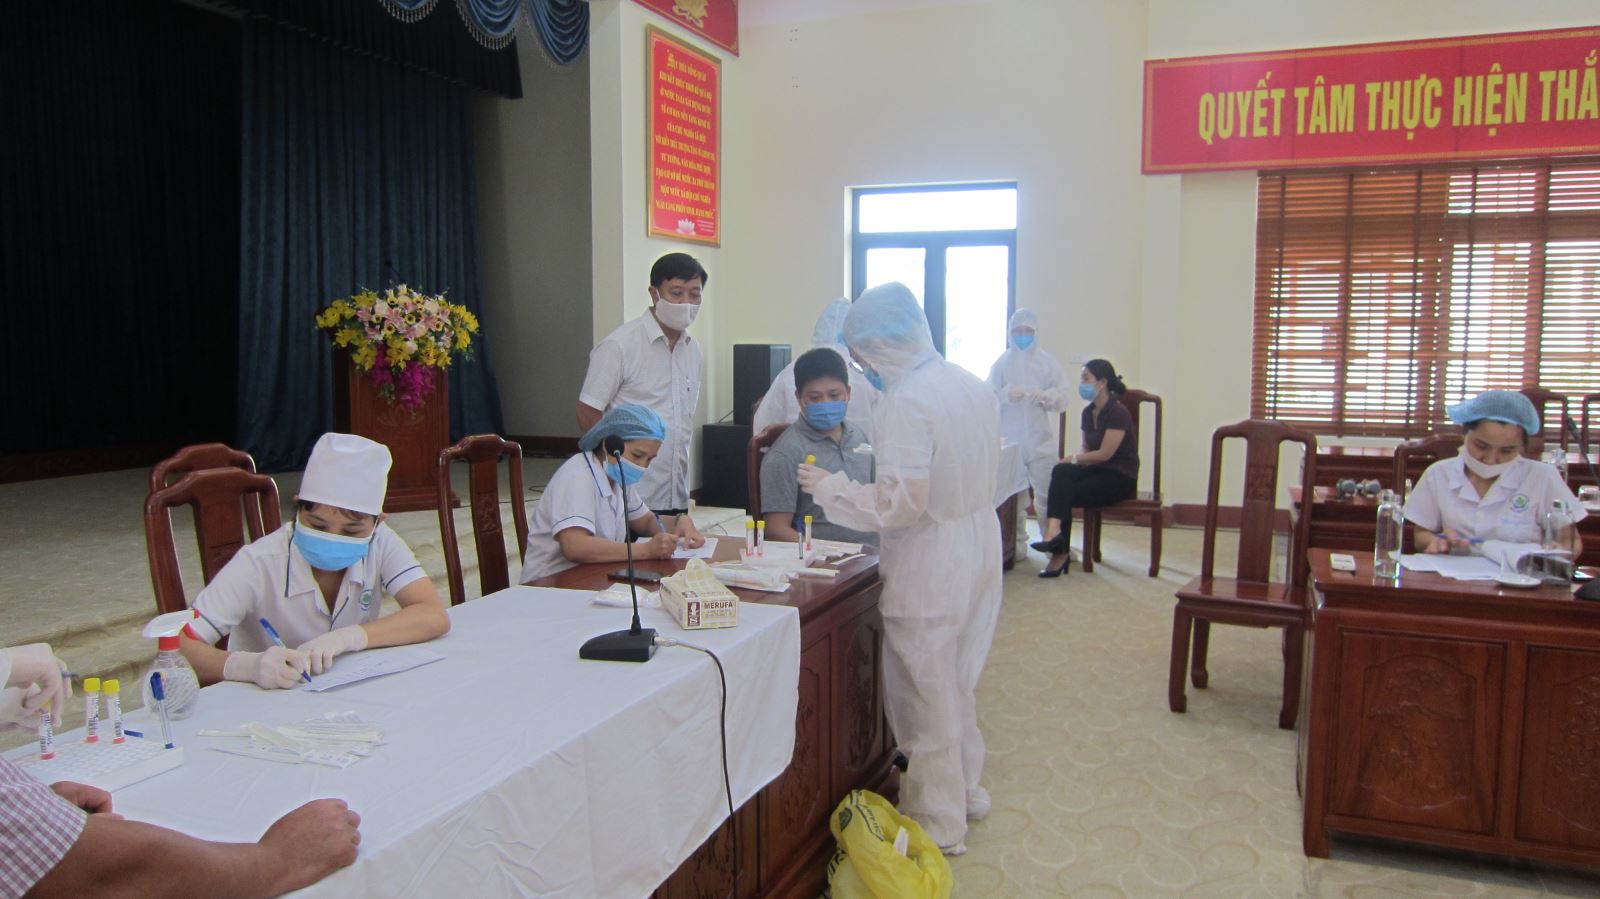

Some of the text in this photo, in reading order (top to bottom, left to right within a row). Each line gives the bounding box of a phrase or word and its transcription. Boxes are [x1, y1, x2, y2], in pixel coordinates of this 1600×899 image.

[1199, 71, 1285, 145] QUYẾT
[1294, 75, 1355, 135] TÂM
[1366, 73, 1443, 140] THỰC
[1452, 63, 1528, 136] HIỆN
[704, 601, 733, 609] MERUFA
